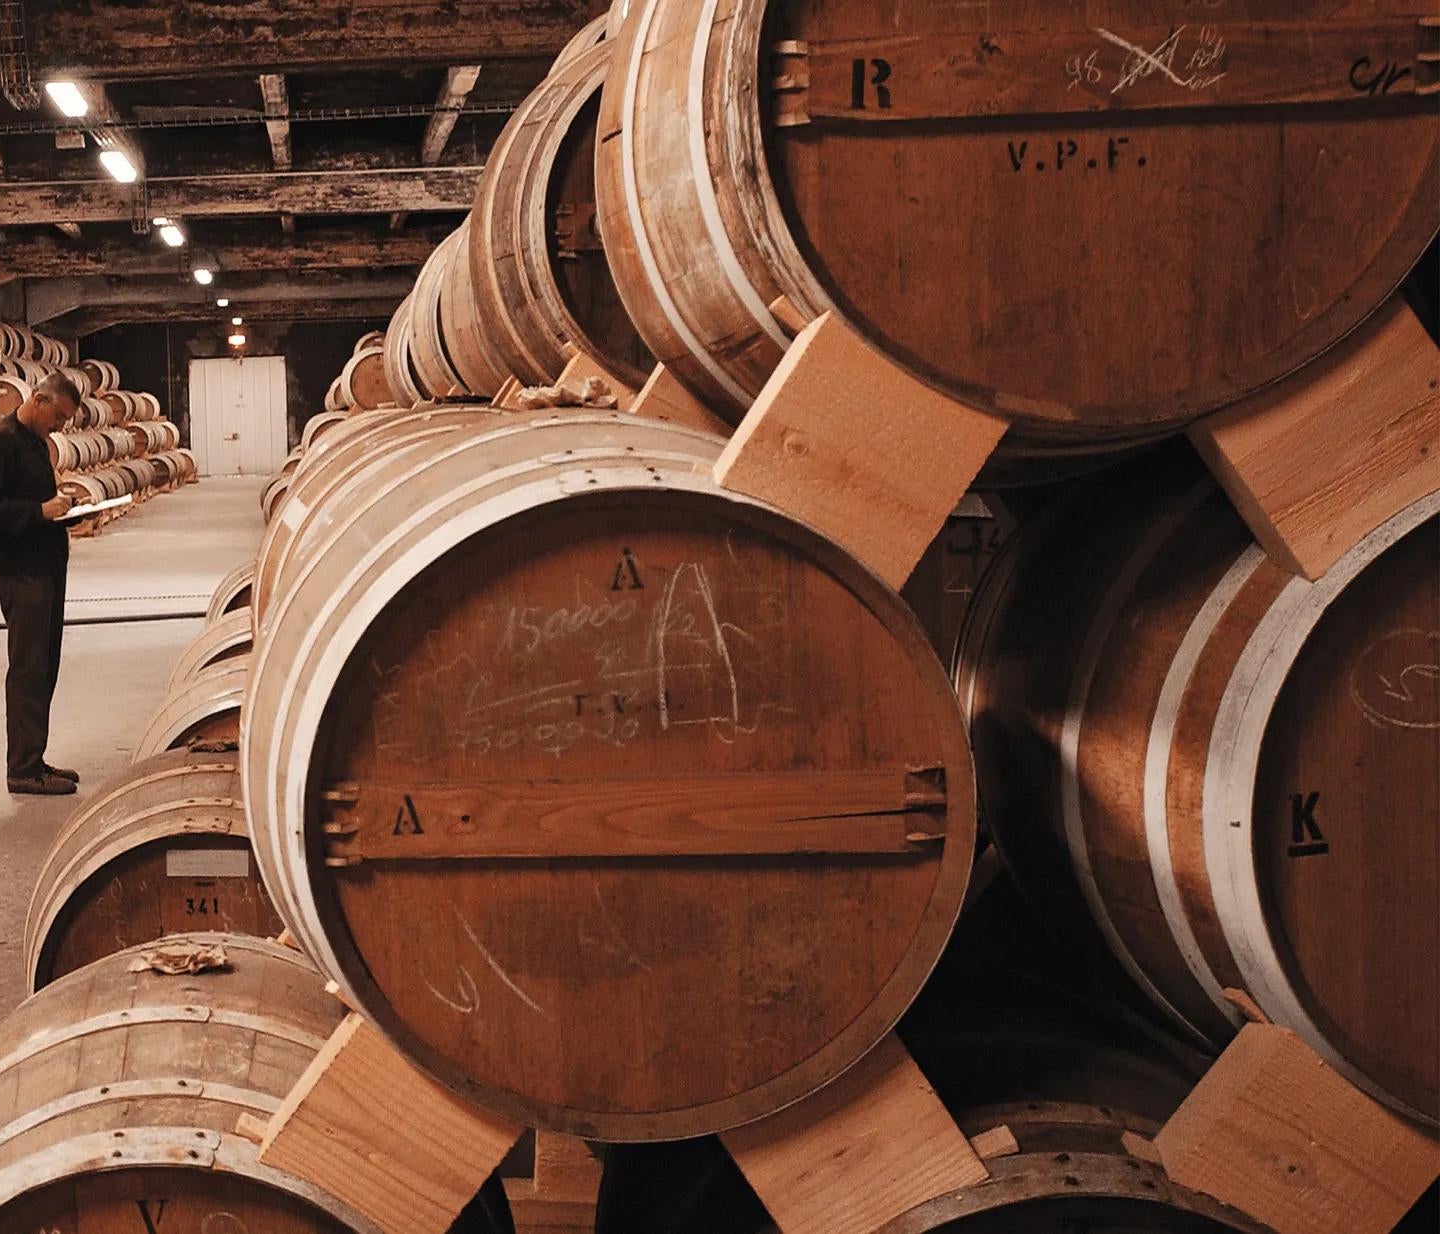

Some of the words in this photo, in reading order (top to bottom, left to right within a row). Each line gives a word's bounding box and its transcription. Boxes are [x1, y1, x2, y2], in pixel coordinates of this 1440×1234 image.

[850, 58, 892, 110] R
[611, 547, 644, 591] A
[392, 794, 425, 836] A
[1290, 791, 1328, 848] K
[185, 898, 220, 915] 341
